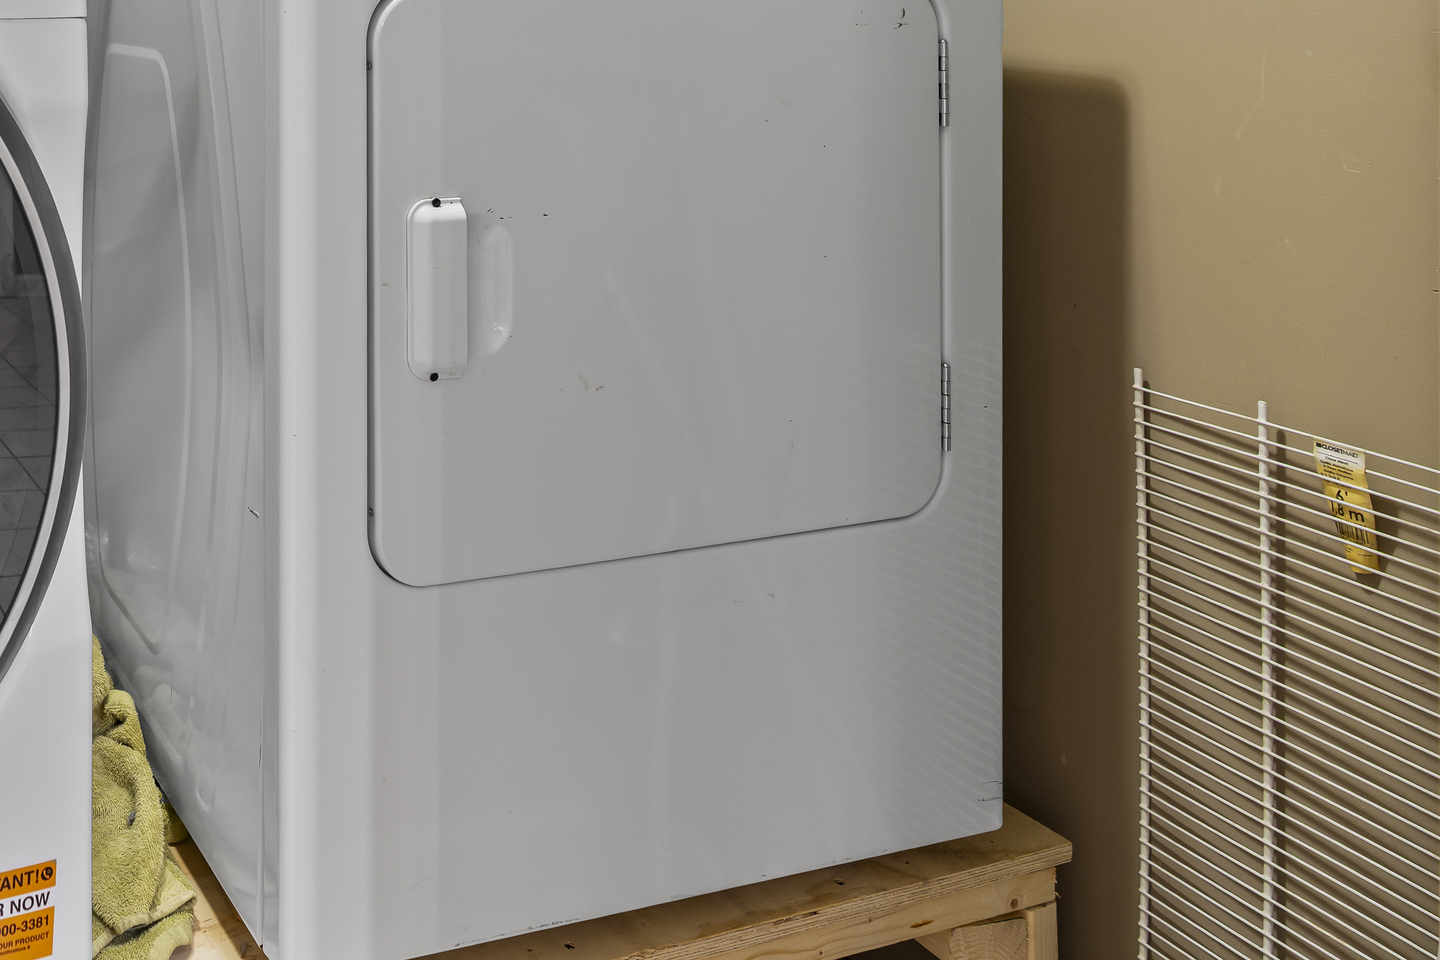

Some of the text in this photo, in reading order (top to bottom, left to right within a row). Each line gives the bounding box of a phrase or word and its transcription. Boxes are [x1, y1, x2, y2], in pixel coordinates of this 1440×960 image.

[1348, 509, 1365, 523] m
[10, 891, 51, 914] NOW
[14, 932, 50, 946] PRODUCT
